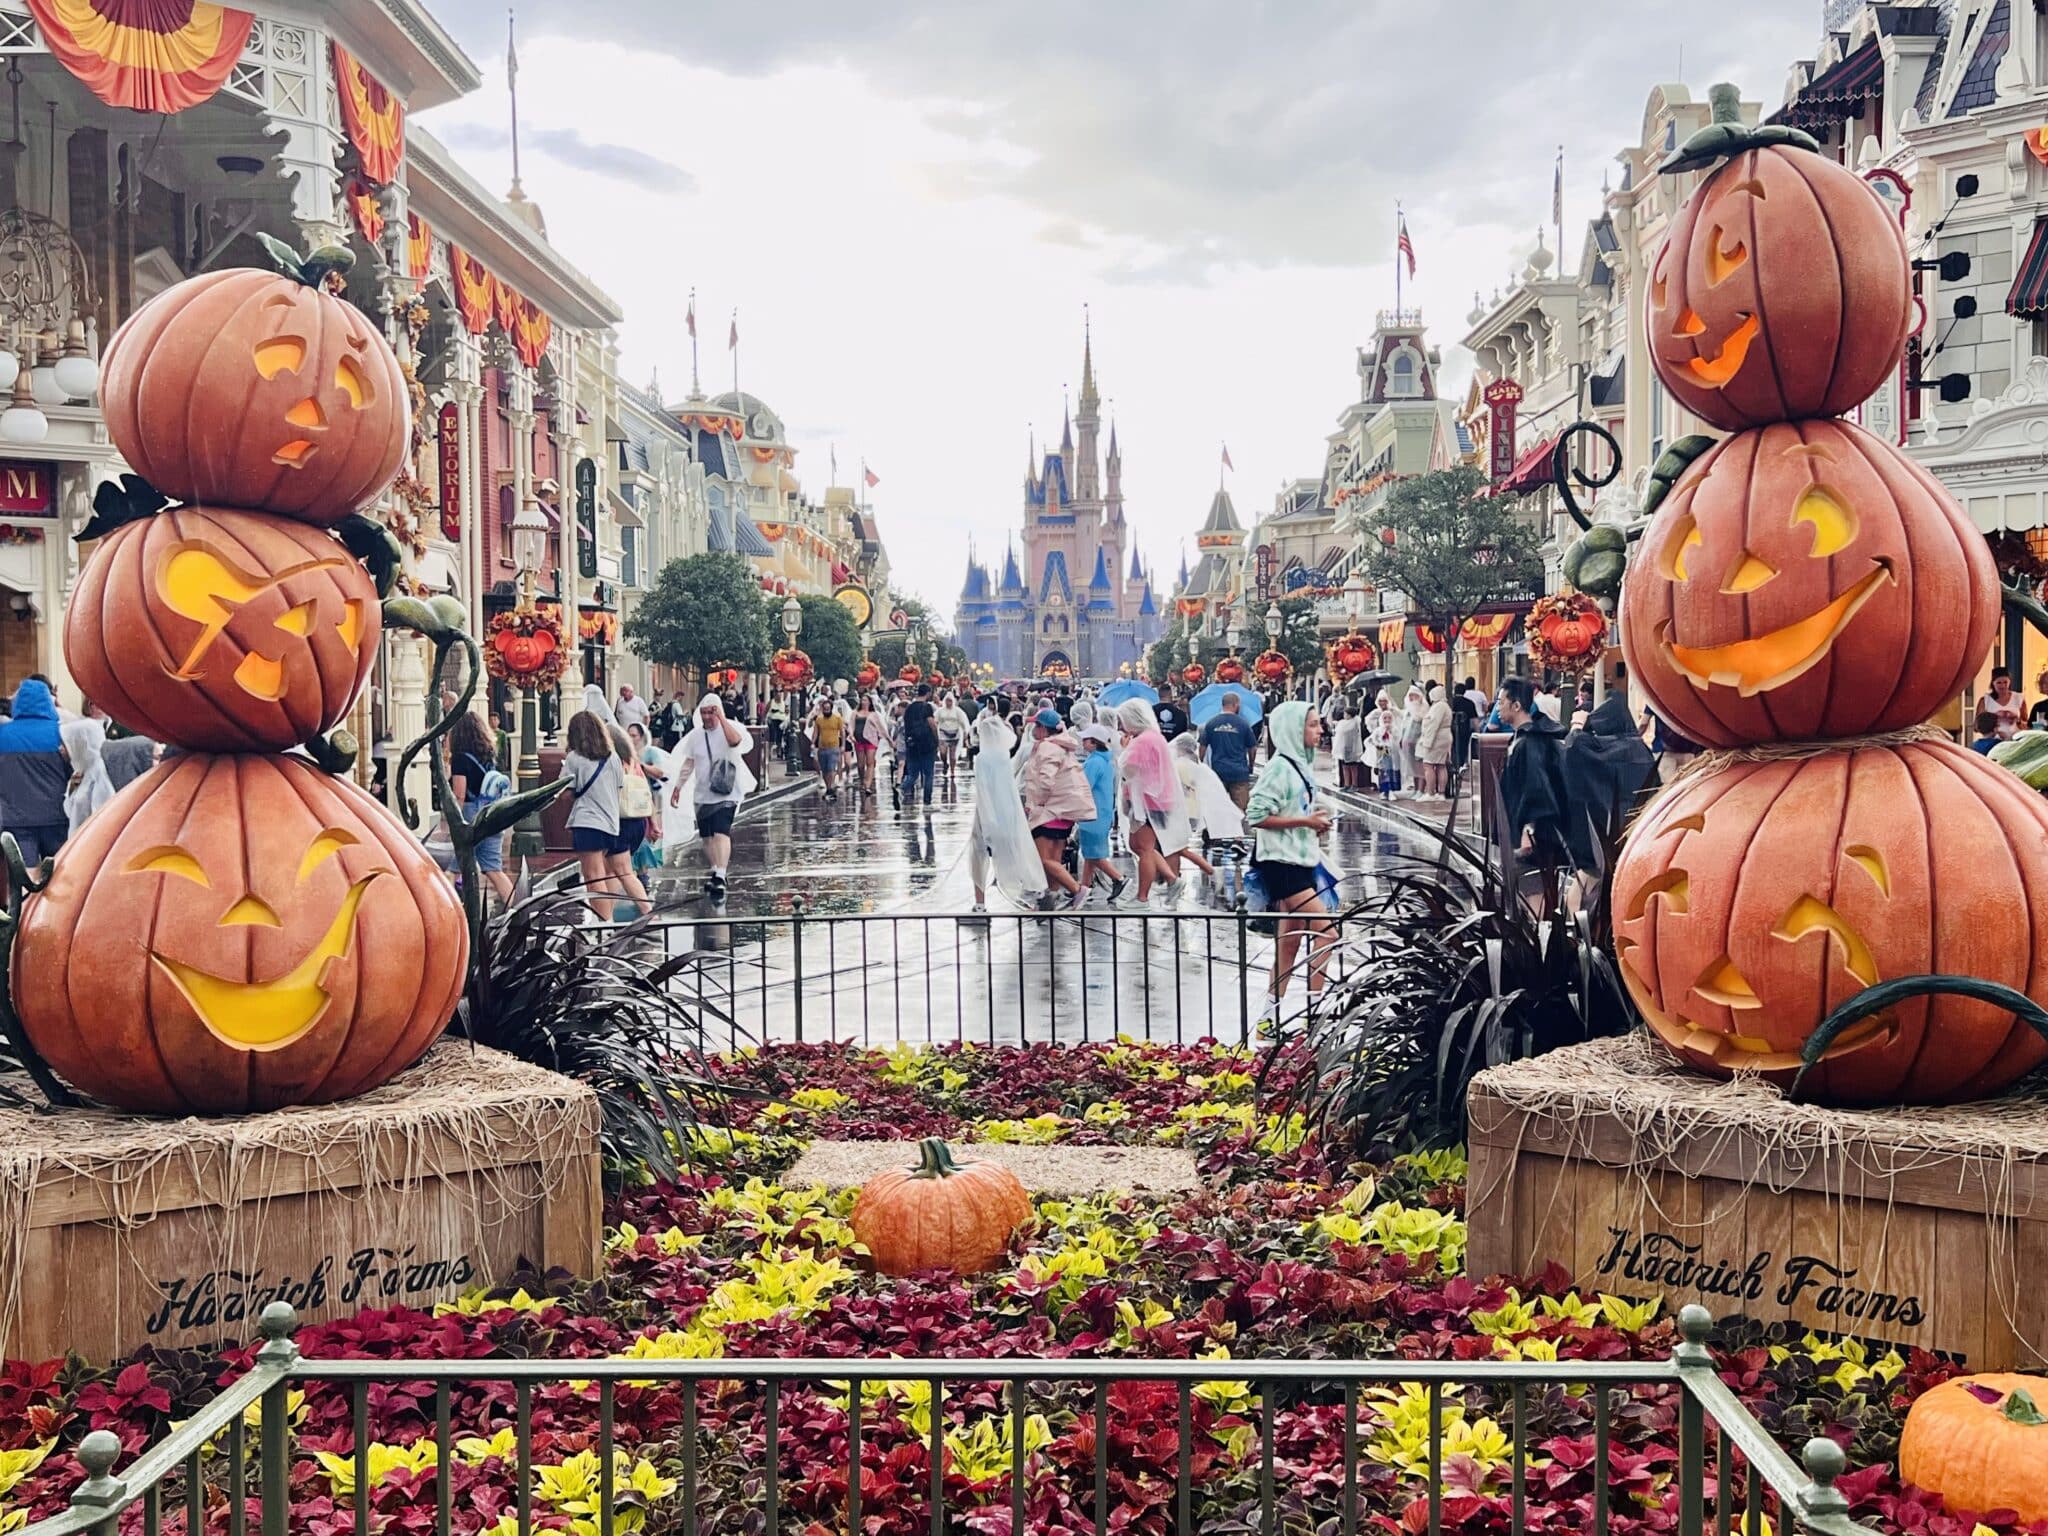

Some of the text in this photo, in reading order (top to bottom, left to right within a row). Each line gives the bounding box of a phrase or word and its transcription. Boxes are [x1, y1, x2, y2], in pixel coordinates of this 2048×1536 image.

[444, 416, 460, 527] EMPORIUM
[146, 1244, 475, 1335] Hartrich Farms
[1597, 1225, 1926, 1327] Hartrich Farms
